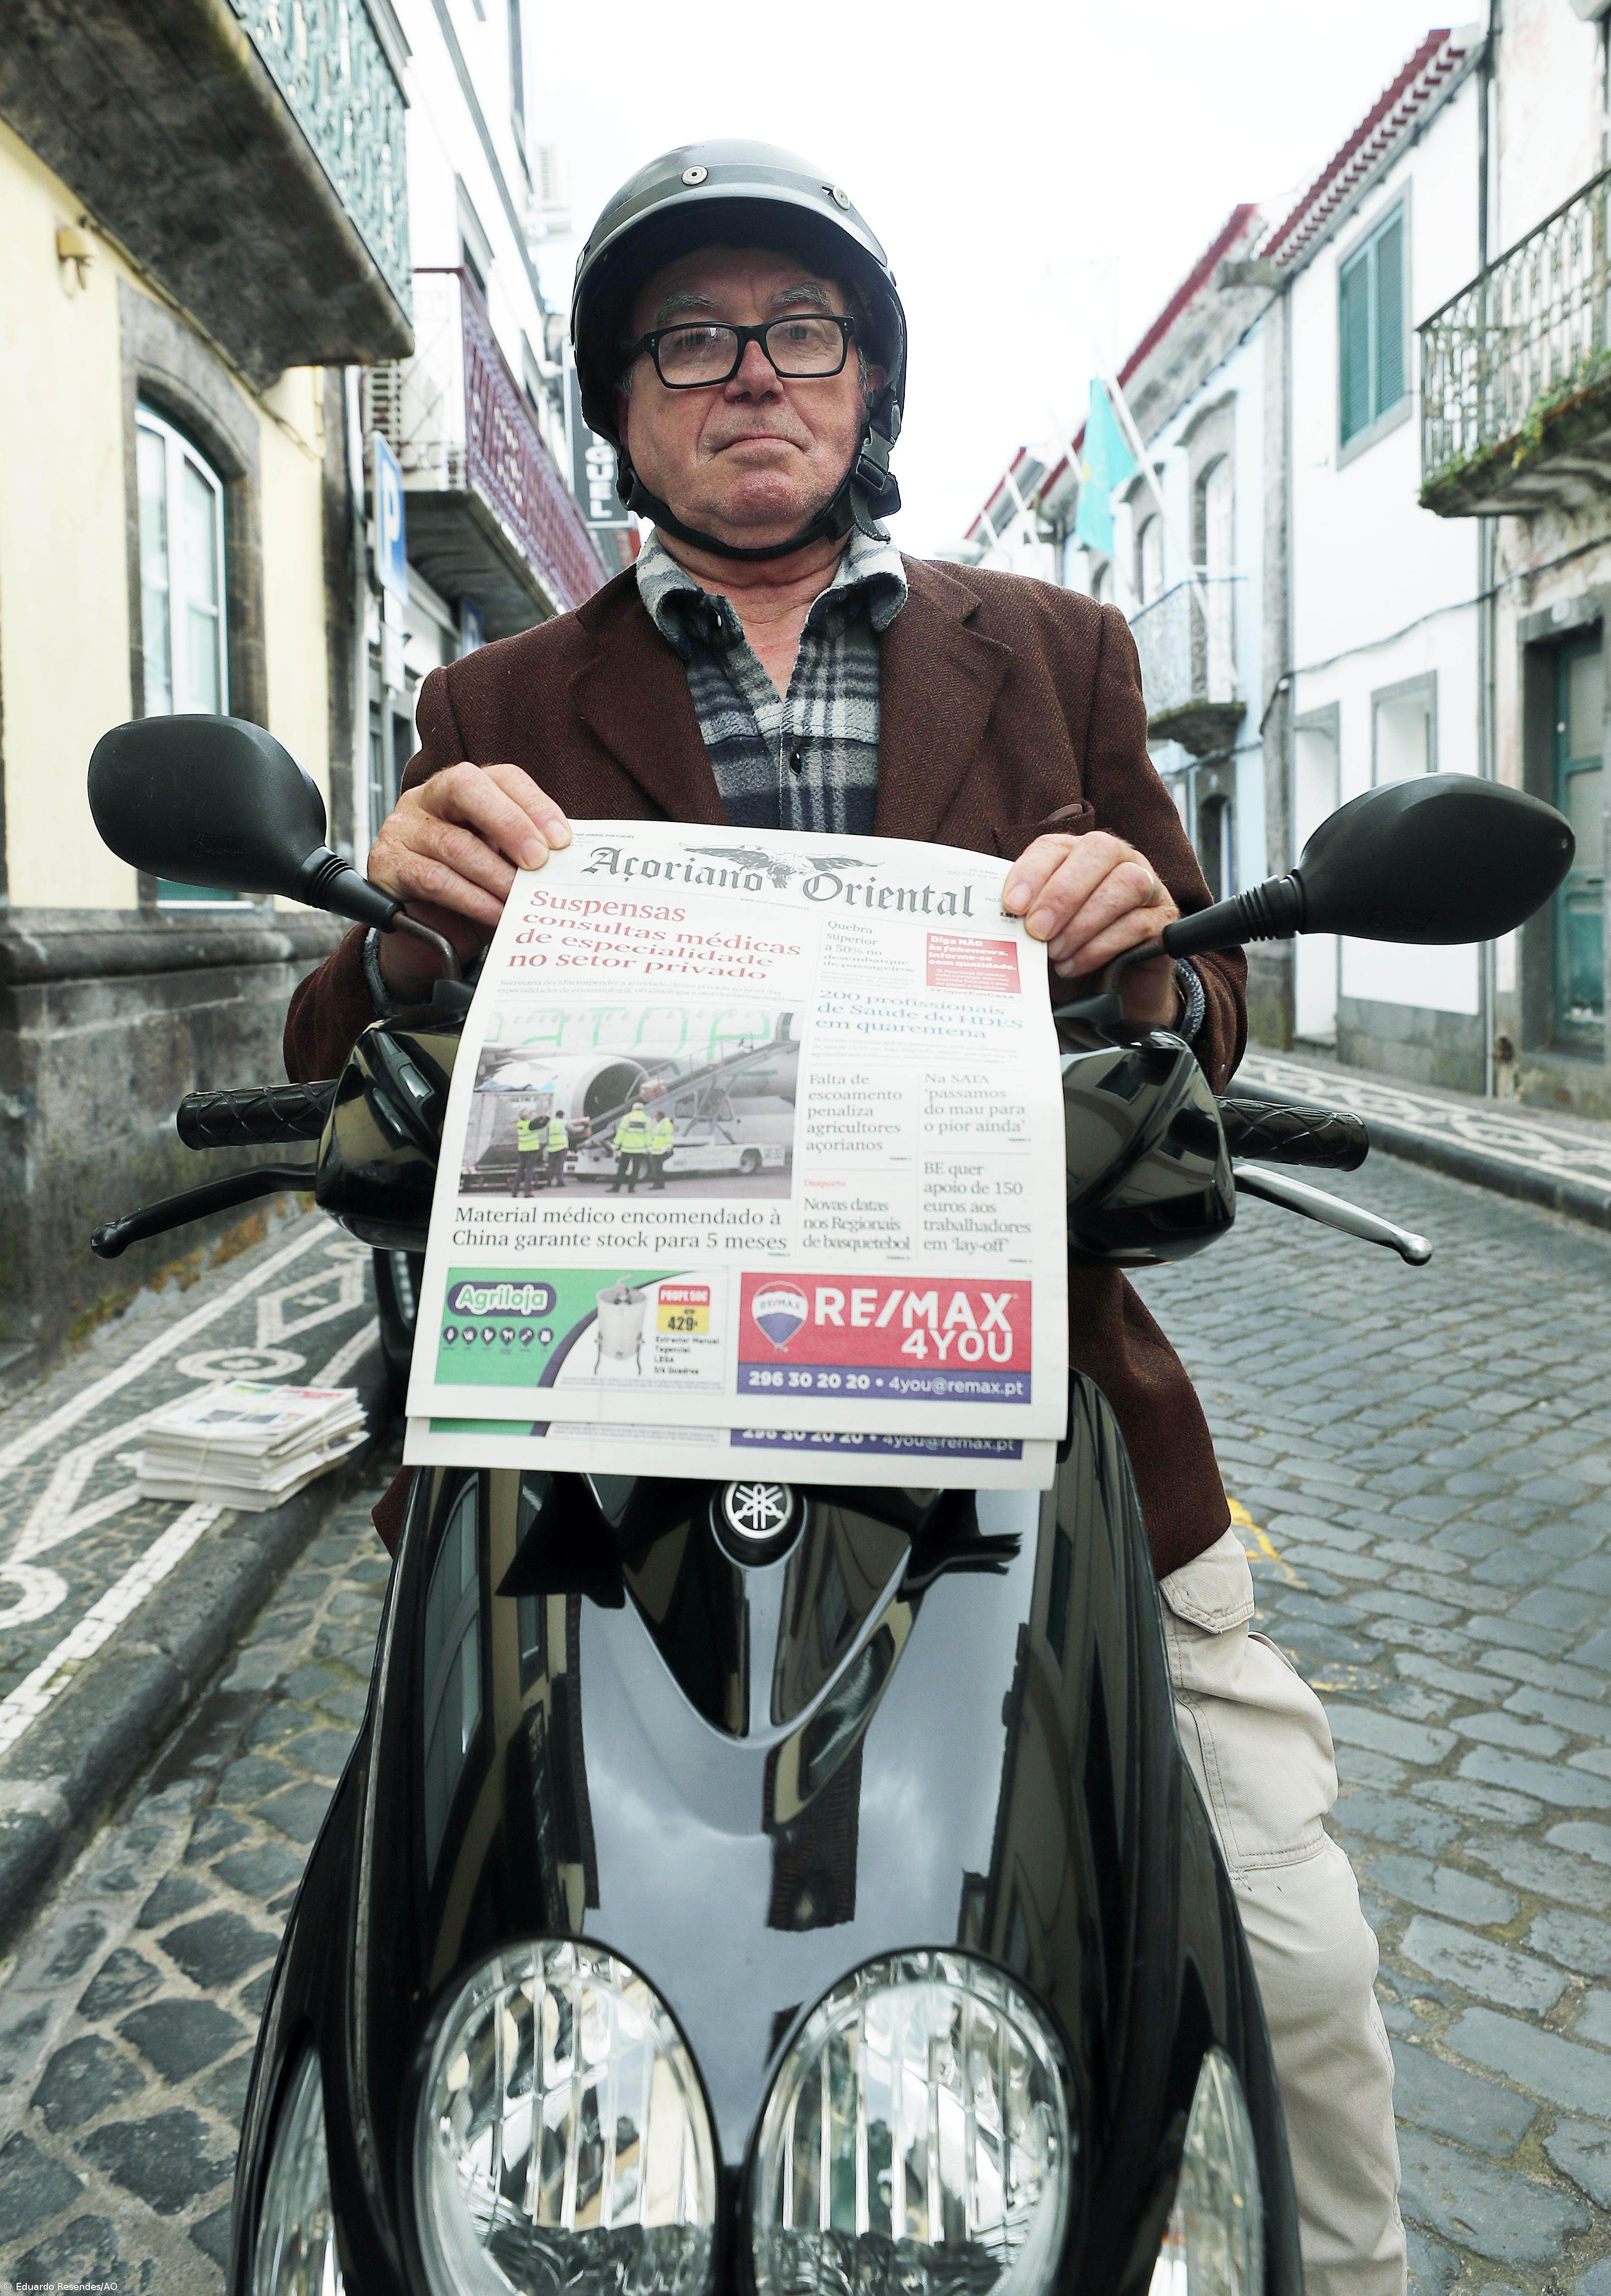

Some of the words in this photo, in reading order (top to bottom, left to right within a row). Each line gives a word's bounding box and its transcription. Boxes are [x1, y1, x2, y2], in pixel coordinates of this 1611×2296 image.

[582, 419, 615, 518] IGUEL
[381, 460, 400, 570] P
[581, 847, 762, 891] Açoriano
[802, 872, 975, 917] Oriental
[530, 891, 685, 921] Suspensas
[523, 914, 666, 940] consultas
[676, 932, 800, 955] médicas
[828, 921, 872, 934] Quebra
[516, 929, 552, 944] de
[561, 936, 773, 966] especialidade
[826, 933, 878, 946] superior
[931, 935, 957, 945] Diga
[958, 938, 984, 947] NÃO
[835, 944, 863, 954] 50%
[928, 952, 992, 961] Informe-se
[507, 955, 547, 966] no
[556, 954, 636, 968] setor
[642, 962, 766, 979] privado
[824, 954, 909, 965] desembarque
[955, 961, 1017, 970] qualidade.
[841, 964, 915, 972] passageiros
[819, 990, 860, 1001] 200
[866, 995, 1005, 1015] profissionais
[818, 1003, 844, 1014] de
[850, 1004, 919, 1019] Saúde
[925, 1011, 952, 1022] do
[960, 1014, 1023, 1029] HDES
[816, 1019, 849, 1030] em
[856, 1021, 986, 1039] quarentena
[810, 1073, 846, 1084] Falta
[851, 1073, 869, 1084] de
[925, 1074, 945, 1083] Na
[951, 1075, 989, 1083] SATA
[809, 1090, 902, 1100] escoamento
[808, 1105, 874, 1119] penaliza
[925, 1103, 944, 1115] do
[949, 1106, 984, 1114] mau
[989, 1106, 1025, 1117] para
[807, 1121, 901, 1136] agricultores
[925, 1123, 934, 1131] o
[939, 1119, 970, 1135] pior
[806, 1138, 883, 1154] açorianos
[925, 1162, 945, 1174] BE
[949, 1166, 985, 1178] quer
[924, 1179, 966, 1197] apoio
[971, 1181, 989, 1194] de
[995, 1181, 1023, 1194] 150
[804, 1197, 847, 1210] Novas
[850, 1197, 889, 1211] datas
[924, 1203, 965, 1212] euros
[971, 1203, 996, 1212] aos
[455, 1207, 537, 1222] Material
[543, 1206, 614, 1223] médico
[621, 1208, 763, 1224] encomendado
[770, 1208, 781, 1224] à
[804, 1219, 828, 1229] nos
[832, 1216, 901, 1233] Regionais
[924, 1218, 1032, 1233] trabalhadores
[453, 1229, 508, 1246] China
[515, 1234, 590, 1251] garante
[596, 1231, 648, 1247] stock
[655, 1235, 699, 1252] para
[707, 1232, 717, 1247] 5
[725, 1237, 787, 1249] meses
[803, 1234, 820, 1247] de
[824, 1234, 910, 1253] basquetebol
[924, 1240, 947, 1249] em
[457, 1286, 546, 1314] Agriloja
[814, 1287, 1013, 1332] RE/MAX
[901, 1328, 1013, 1362] 4YOU
[748, 1370, 784, 1387] 296
[787, 1371, 813, 1388] 30
[817, 1372, 842, 1389] 20
[845, 1373, 871, 1390] 20
[888, 1375, 1024, 1397] 4you@remax.pt
